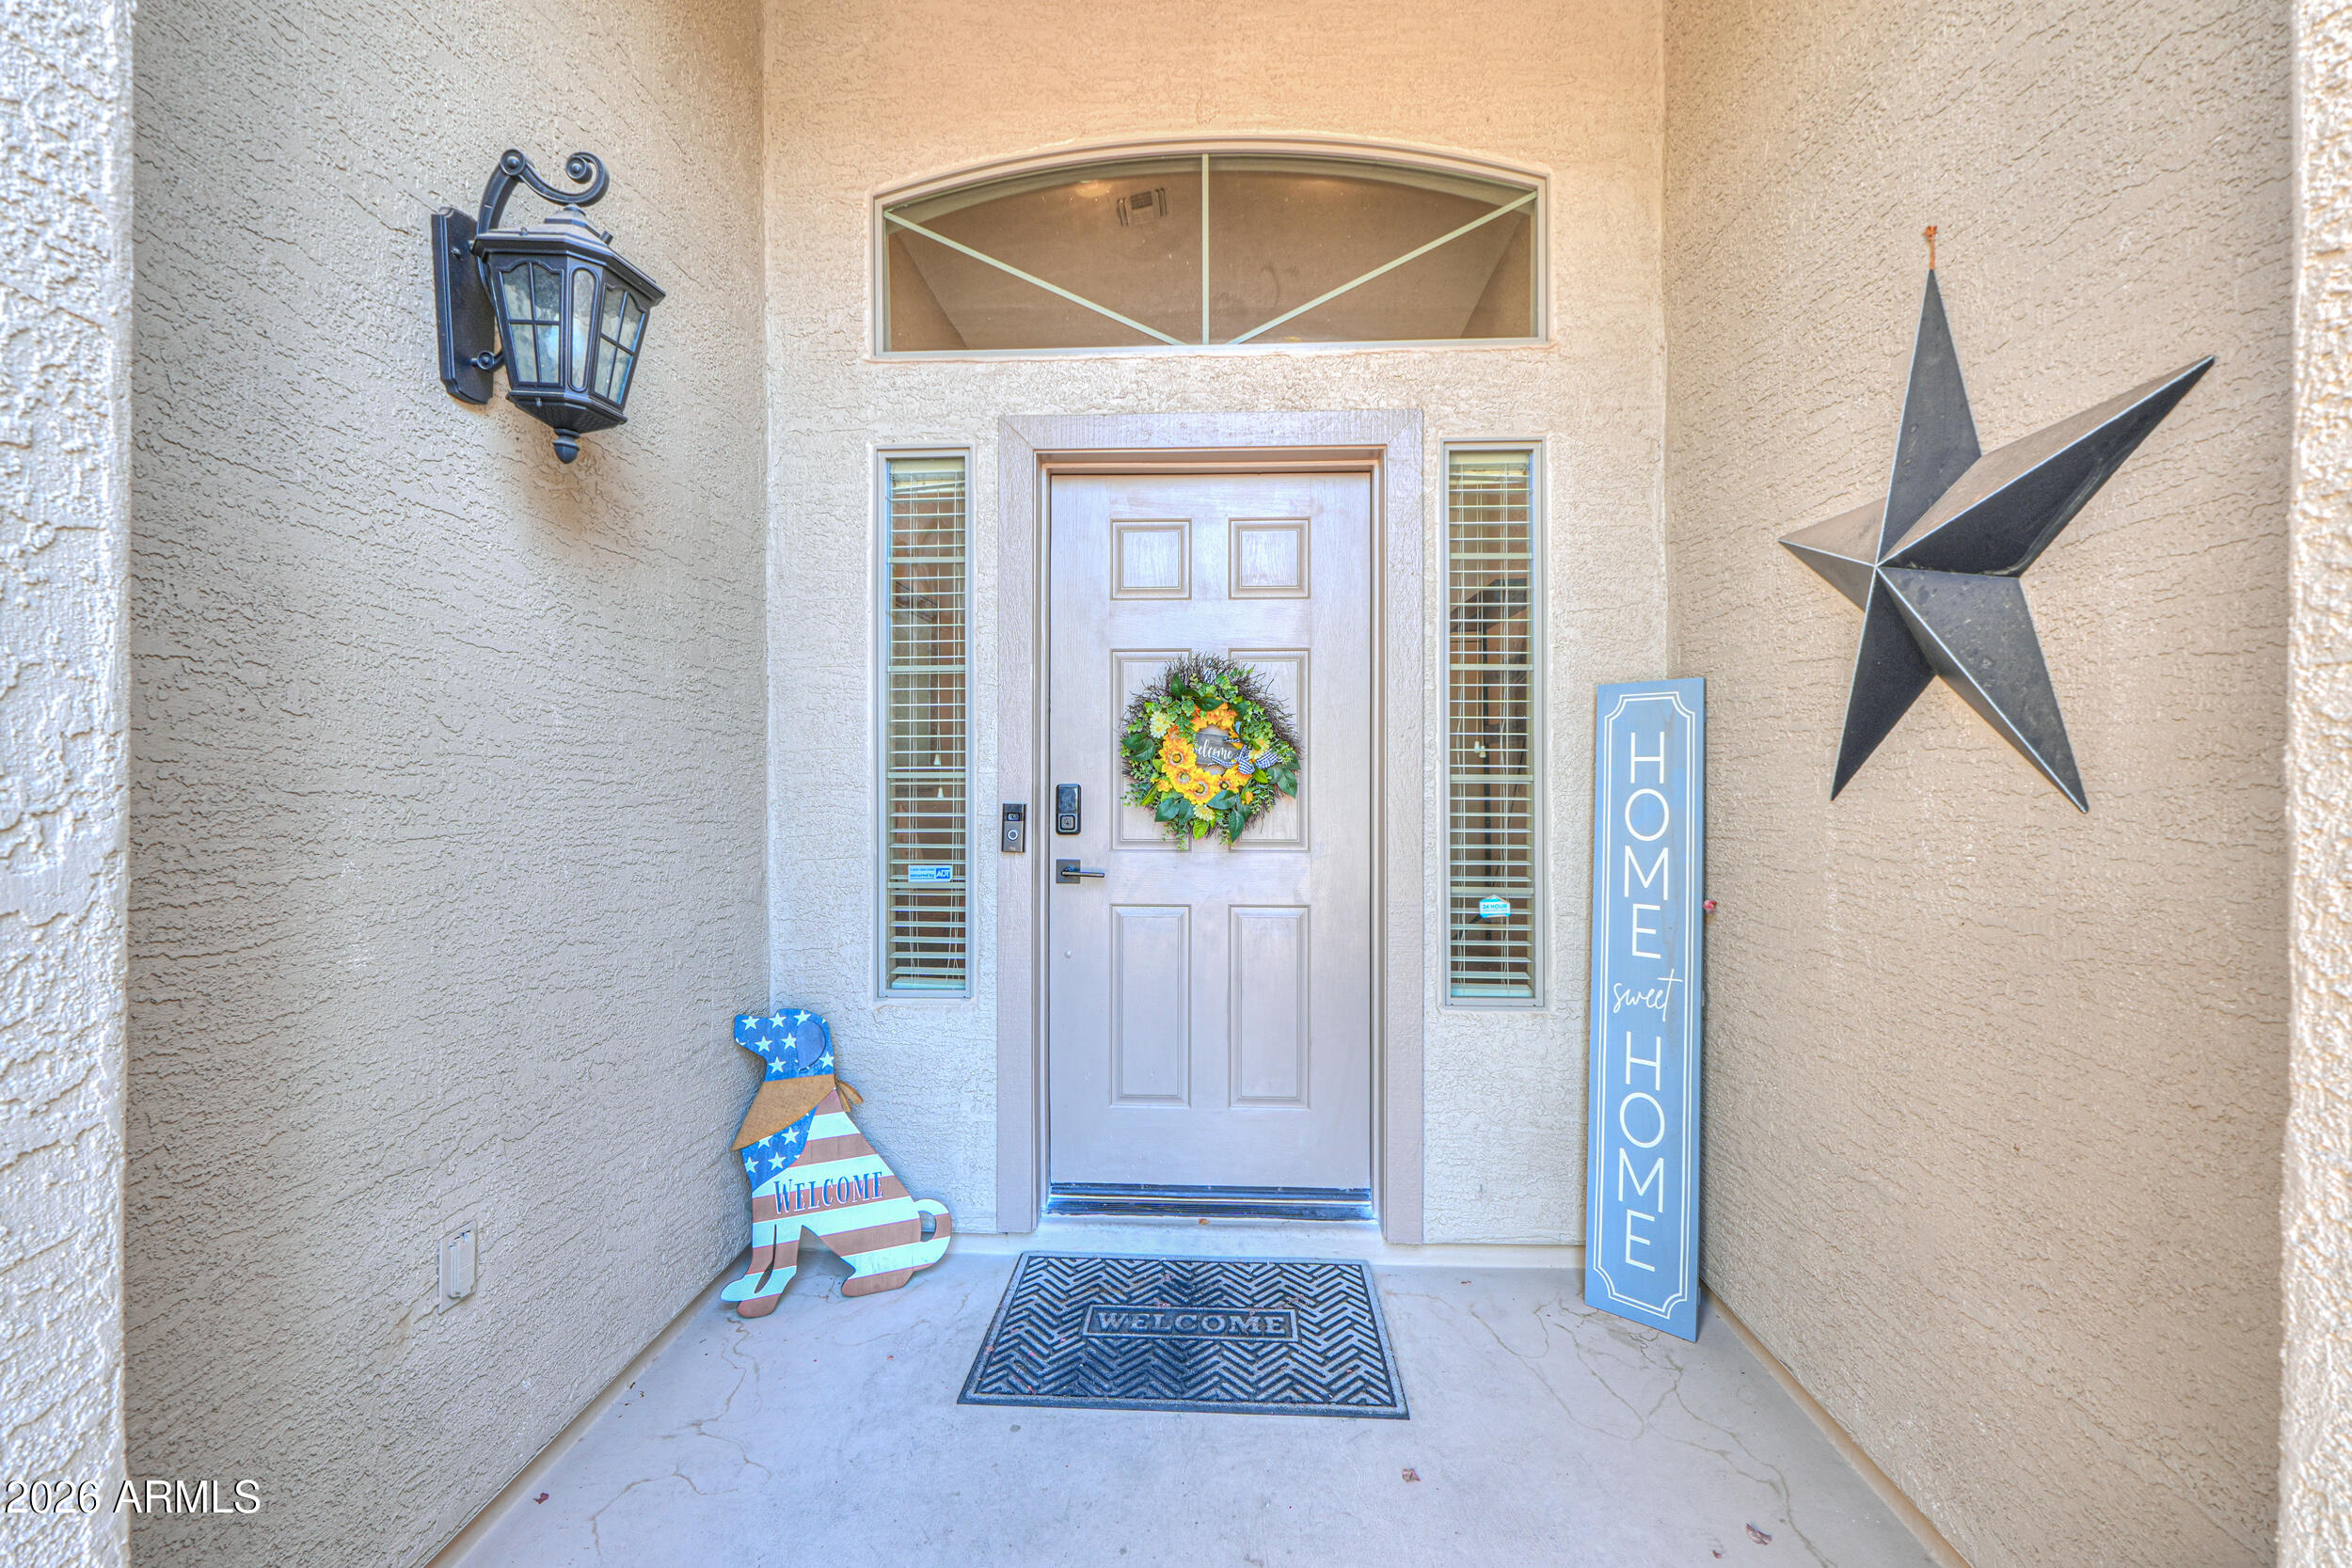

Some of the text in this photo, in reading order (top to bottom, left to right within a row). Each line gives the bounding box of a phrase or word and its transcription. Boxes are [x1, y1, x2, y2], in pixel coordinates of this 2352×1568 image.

[1623, 731, 1670, 959] HOME
[936, 869, 950, 878] ADT
[1613, 968, 1684, 1022] sweet
[1617, 1031, 1665, 1273] HOME
[773, 1171, 883, 1214] WELCOME
[1097, 1311, 1286, 1336] WELCOME
